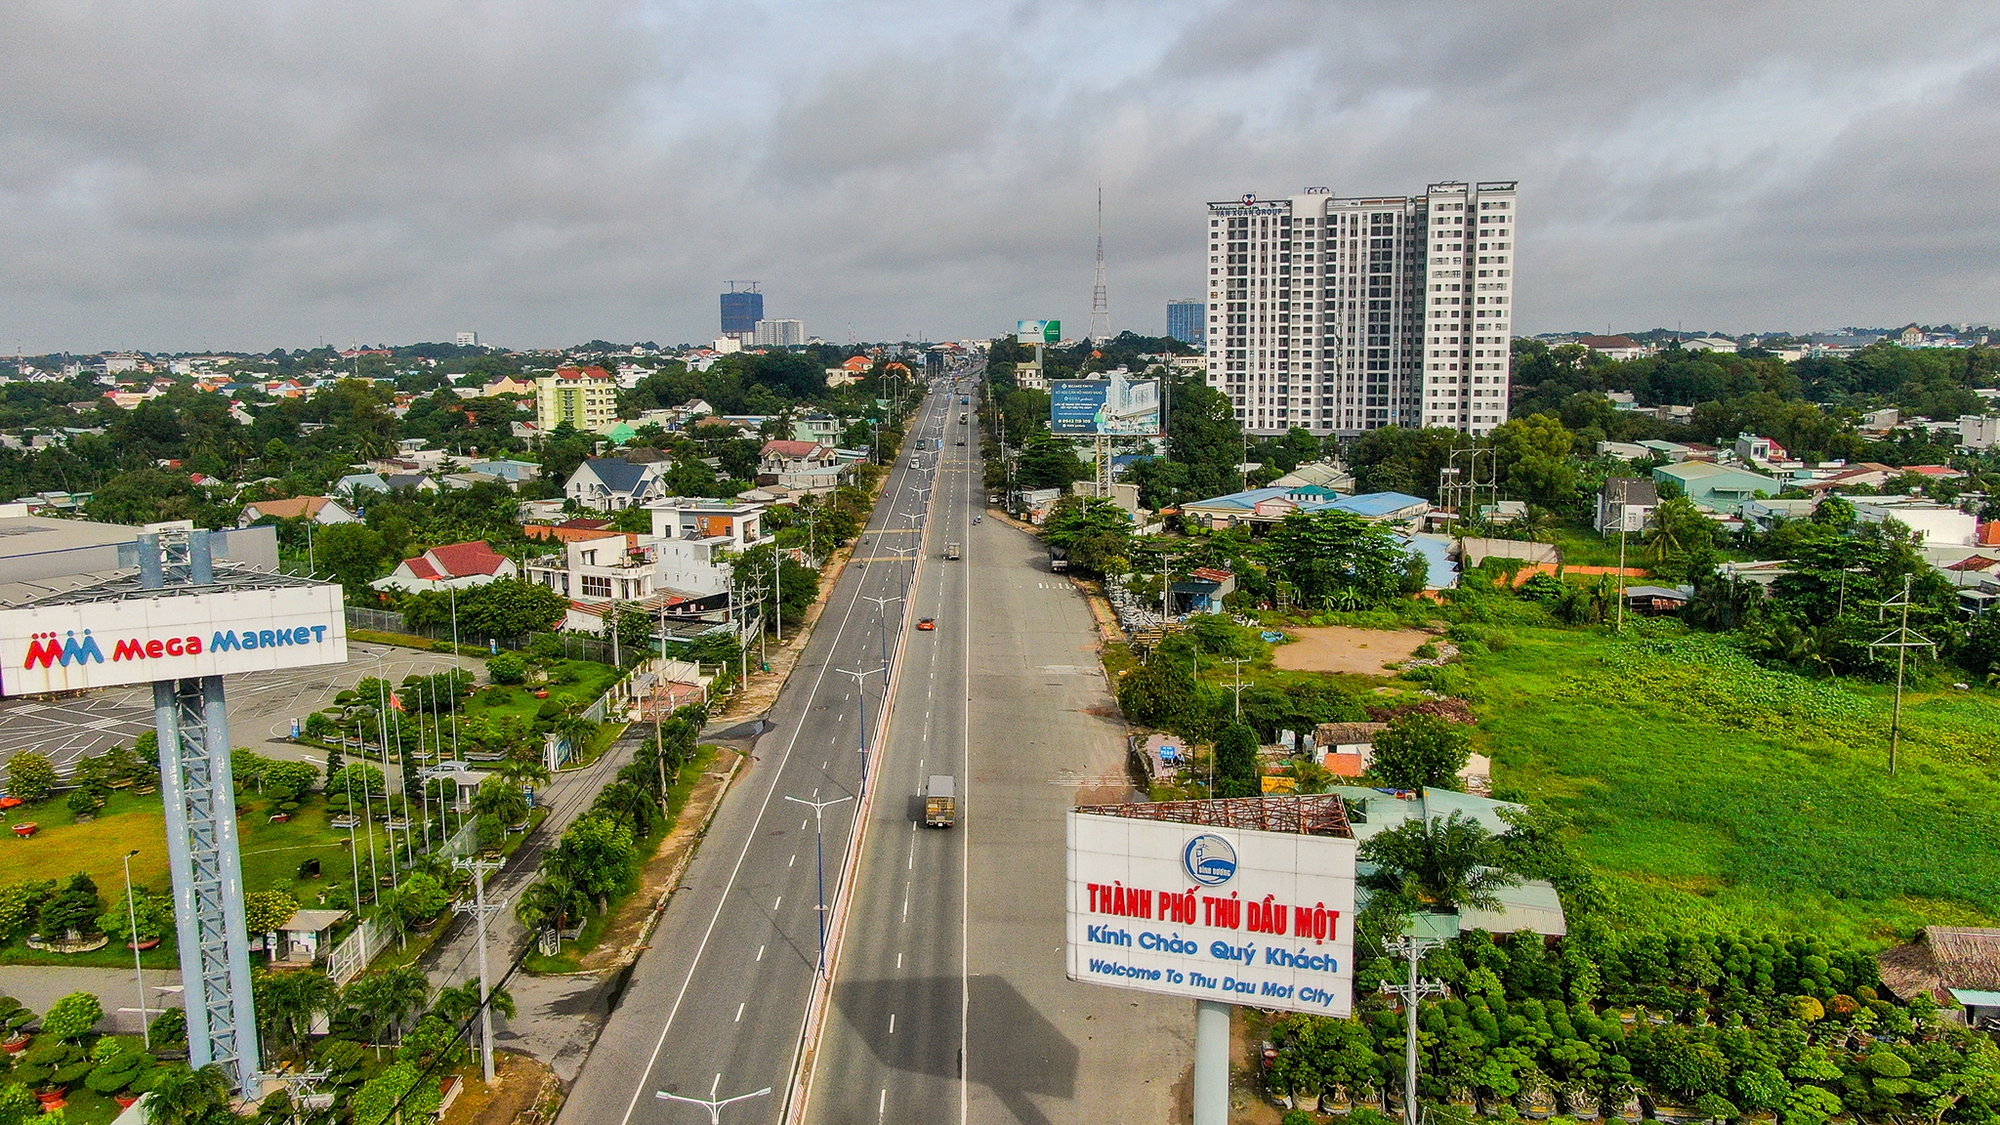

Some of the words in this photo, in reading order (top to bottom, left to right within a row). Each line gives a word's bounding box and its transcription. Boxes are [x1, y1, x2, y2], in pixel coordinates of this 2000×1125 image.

[1255, 208, 1283, 216] GROUP
[1087, 880, 1152, 920] THÀNH
[1159, 886, 1201, 926] PHỐ
[1203, 891, 1241, 931] THỦ
[1248, 893, 1288, 936] DẦU
[1295, 901, 1341, 945] MỘT
[1087, 924, 1133, 947] Kính
[1138, 932, 1199, 955] Chào
[1210, 941, 1257, 966] Quý
[1265, 946, 1339, 973] Khách
[1088, 958, 1162, 981] Welcome
[1166, 968, 1184, 984] To
[1189, 972, 1217, 989] Thu
[1222, 976, 1257, 995] Dau
[1261, 981, 1295, 999] Mot
[1299, 987, 1336, 1007] City
